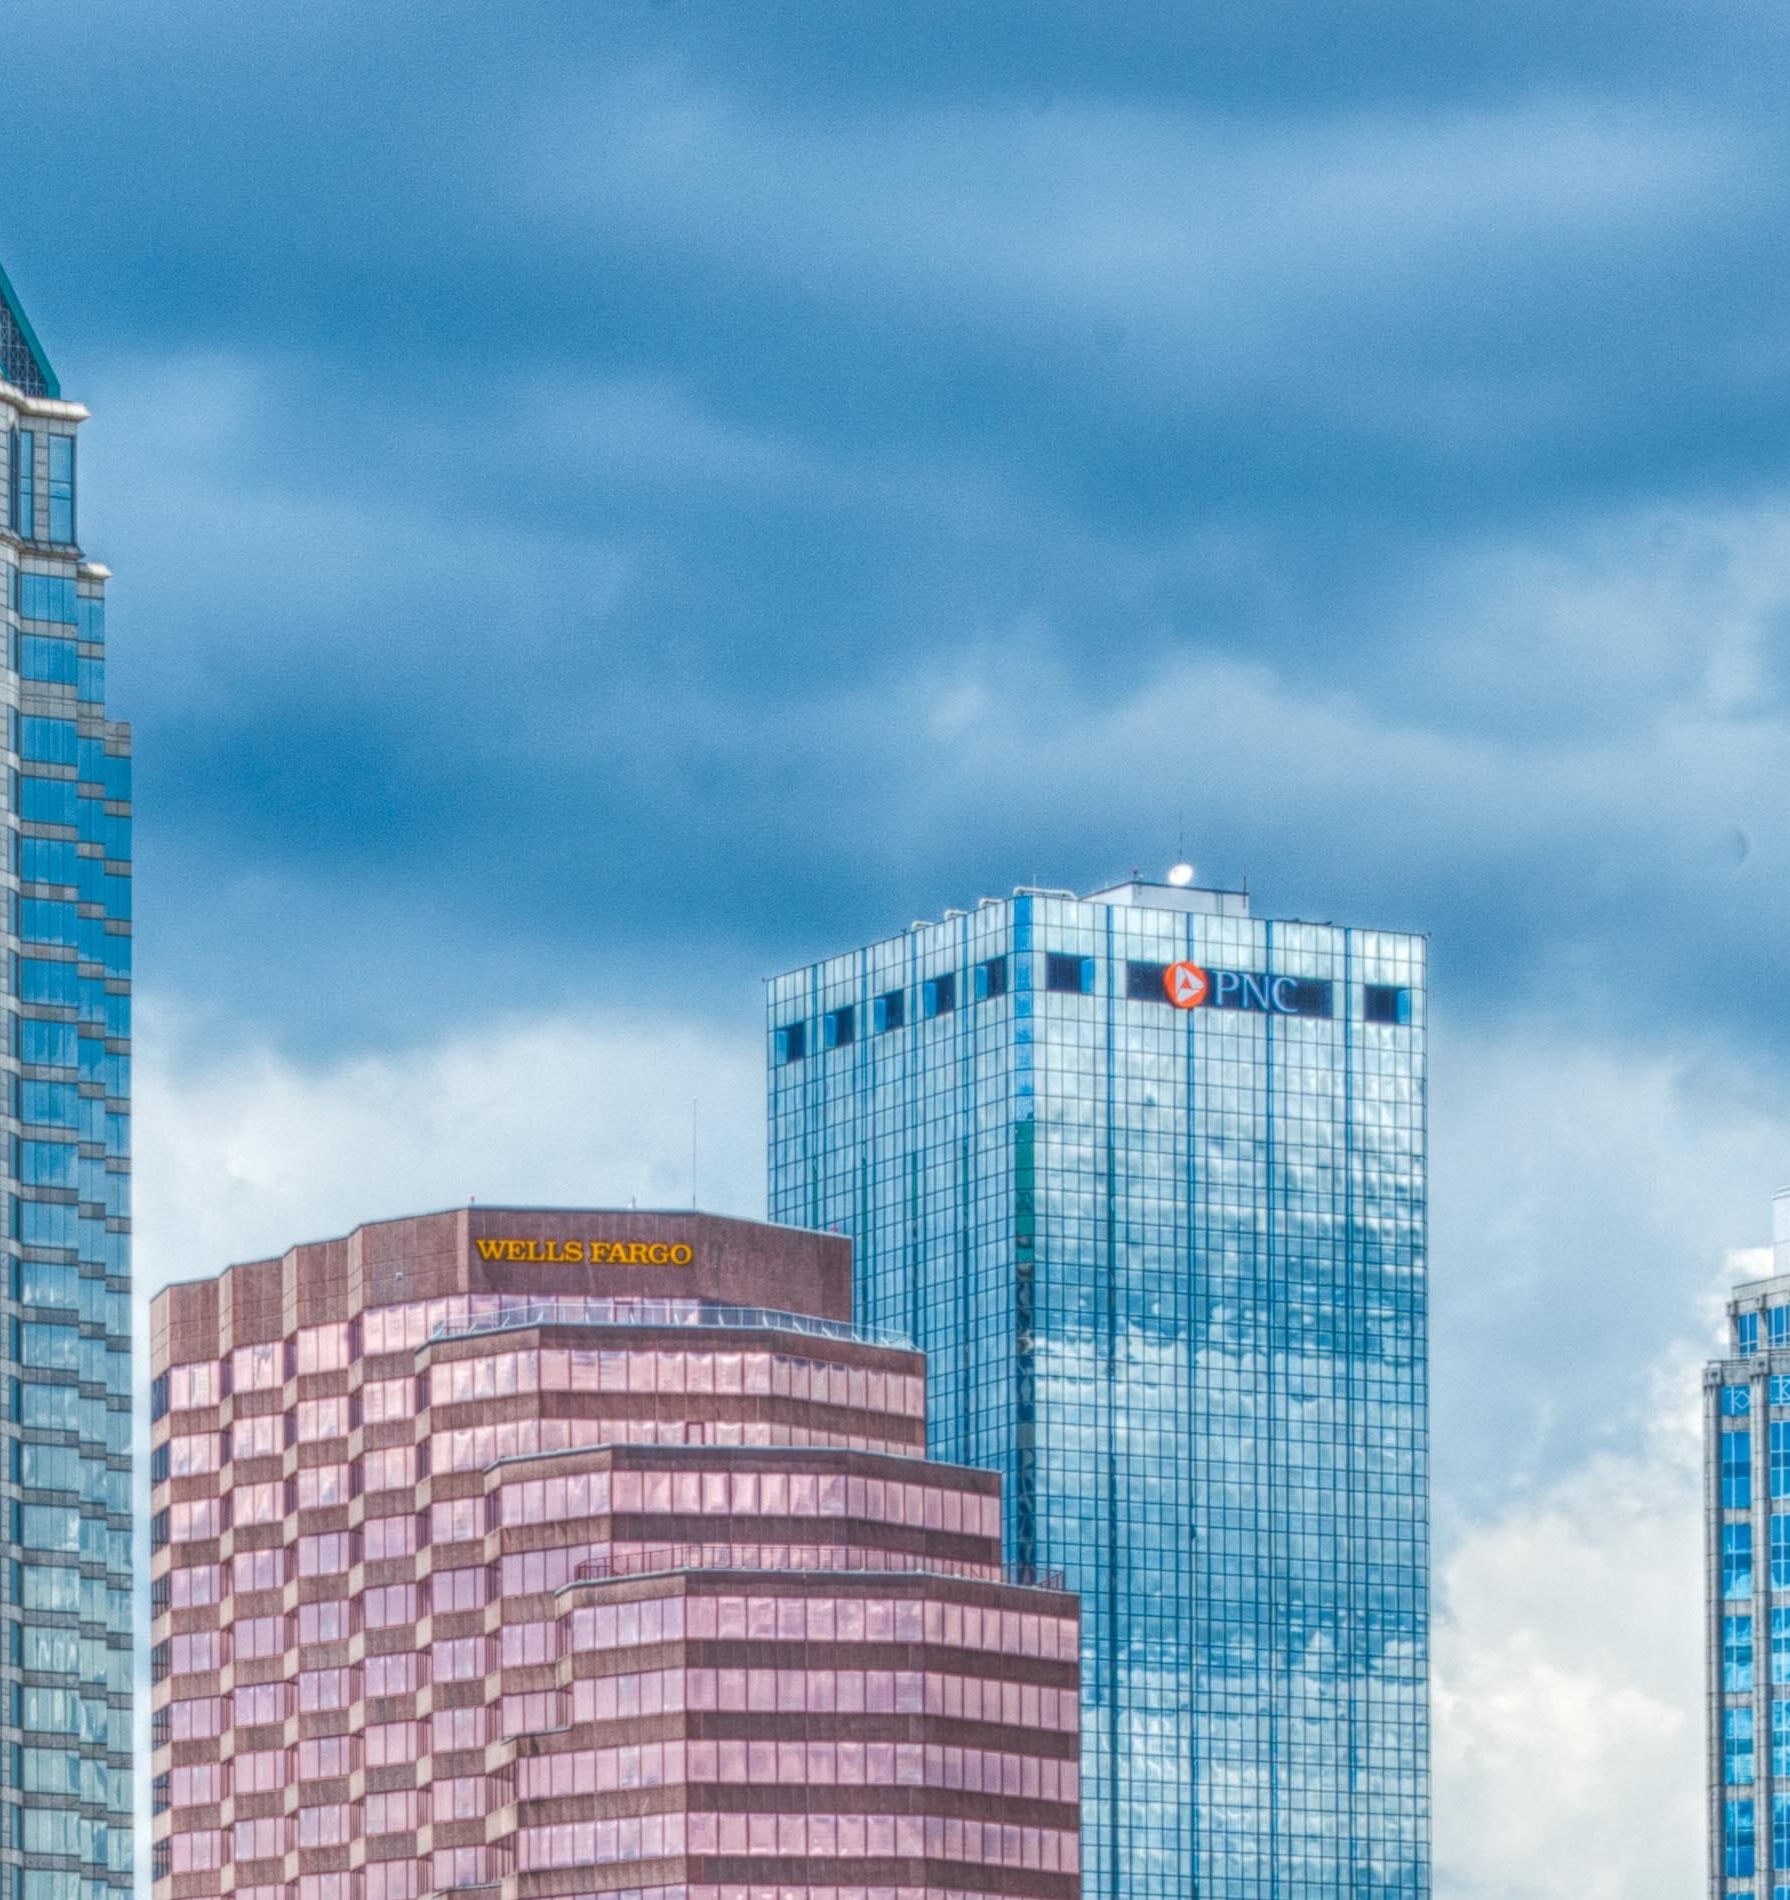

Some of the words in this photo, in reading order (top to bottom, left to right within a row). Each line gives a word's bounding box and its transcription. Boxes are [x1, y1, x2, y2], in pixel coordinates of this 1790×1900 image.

[1211, 970, 1299, 1014] PNC
[476, 1239, 584, 1263] WELLS
[590, 1241, 694, 1266] FARGO
